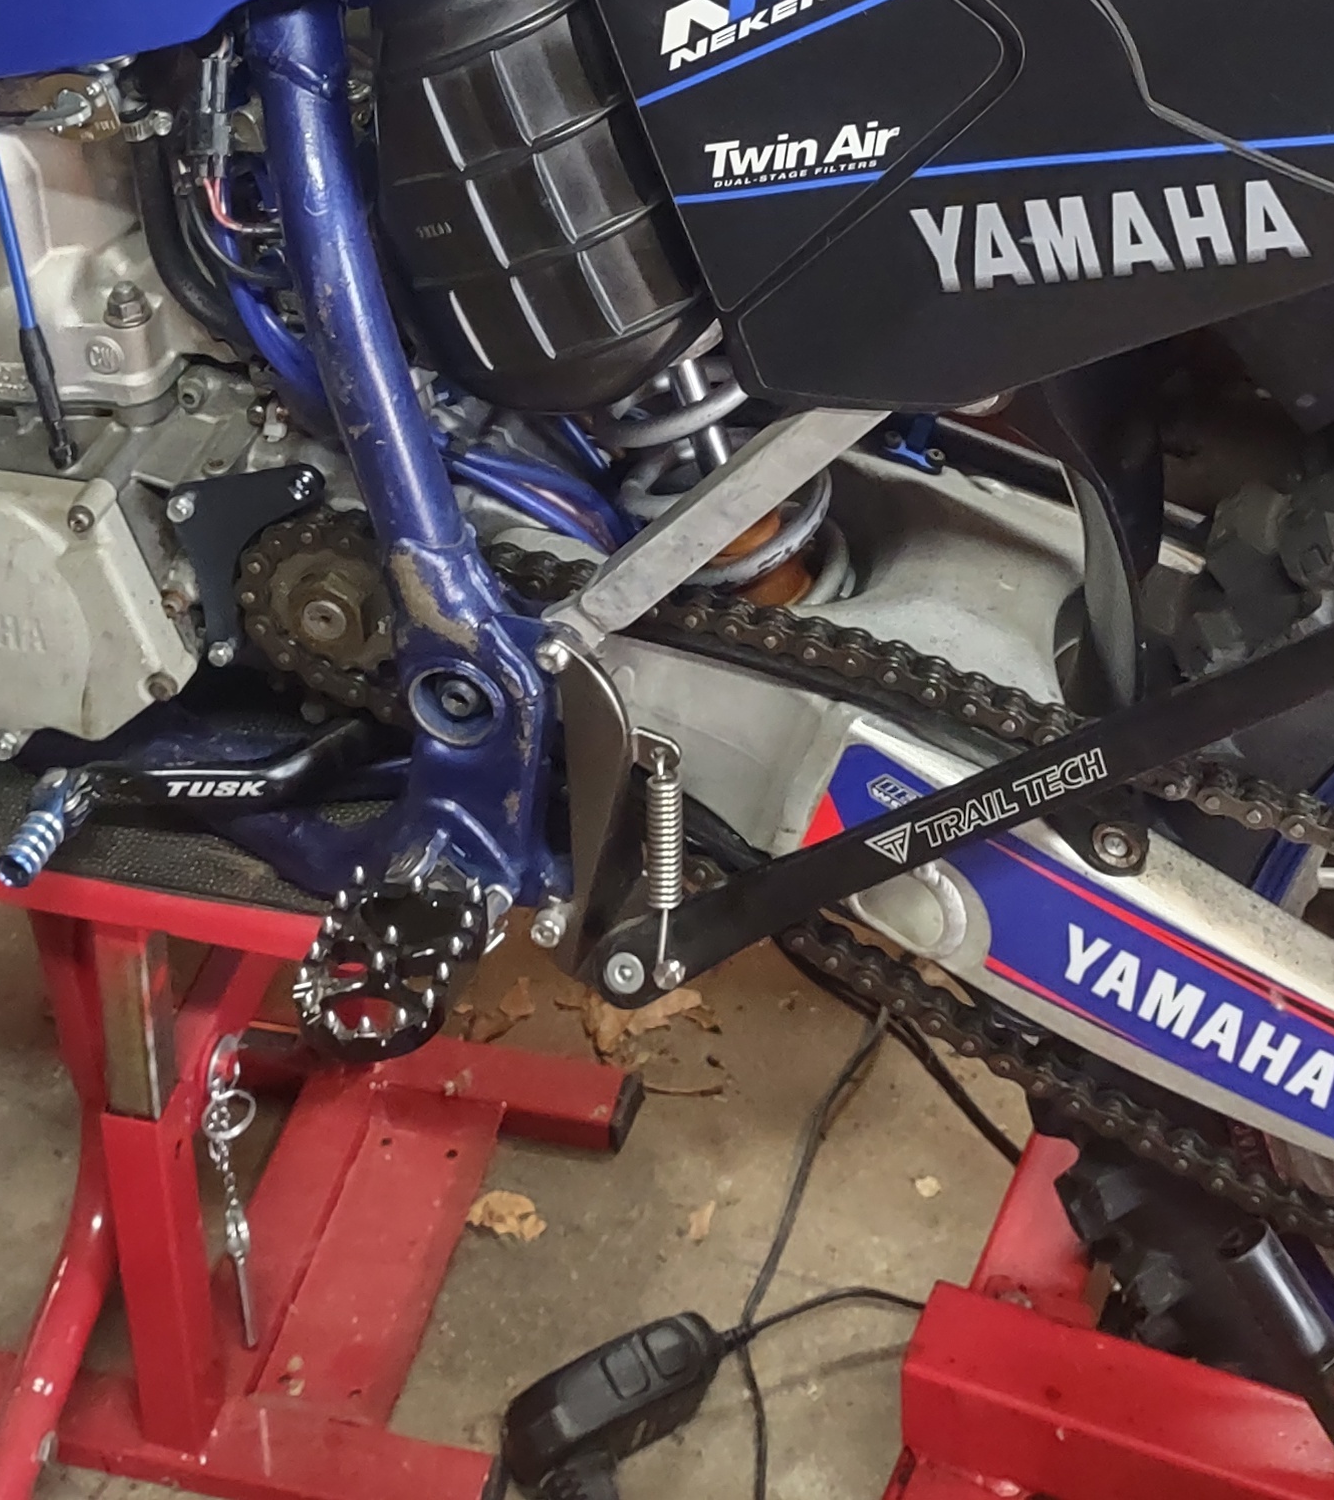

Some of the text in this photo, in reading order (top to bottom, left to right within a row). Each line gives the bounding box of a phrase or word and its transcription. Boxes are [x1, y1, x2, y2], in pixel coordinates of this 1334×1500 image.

[704, 120, 901, 179] Twin Air
[713, 159, 878, 189] DUAL-STAGE FILTERS
[911, 179, 1313, 293] YAMAHA
[167, 780, 267, 798] TUSK
[914, 788, 1020, 848] TRAIL
[1012, 747, 1109, 807] TECH
